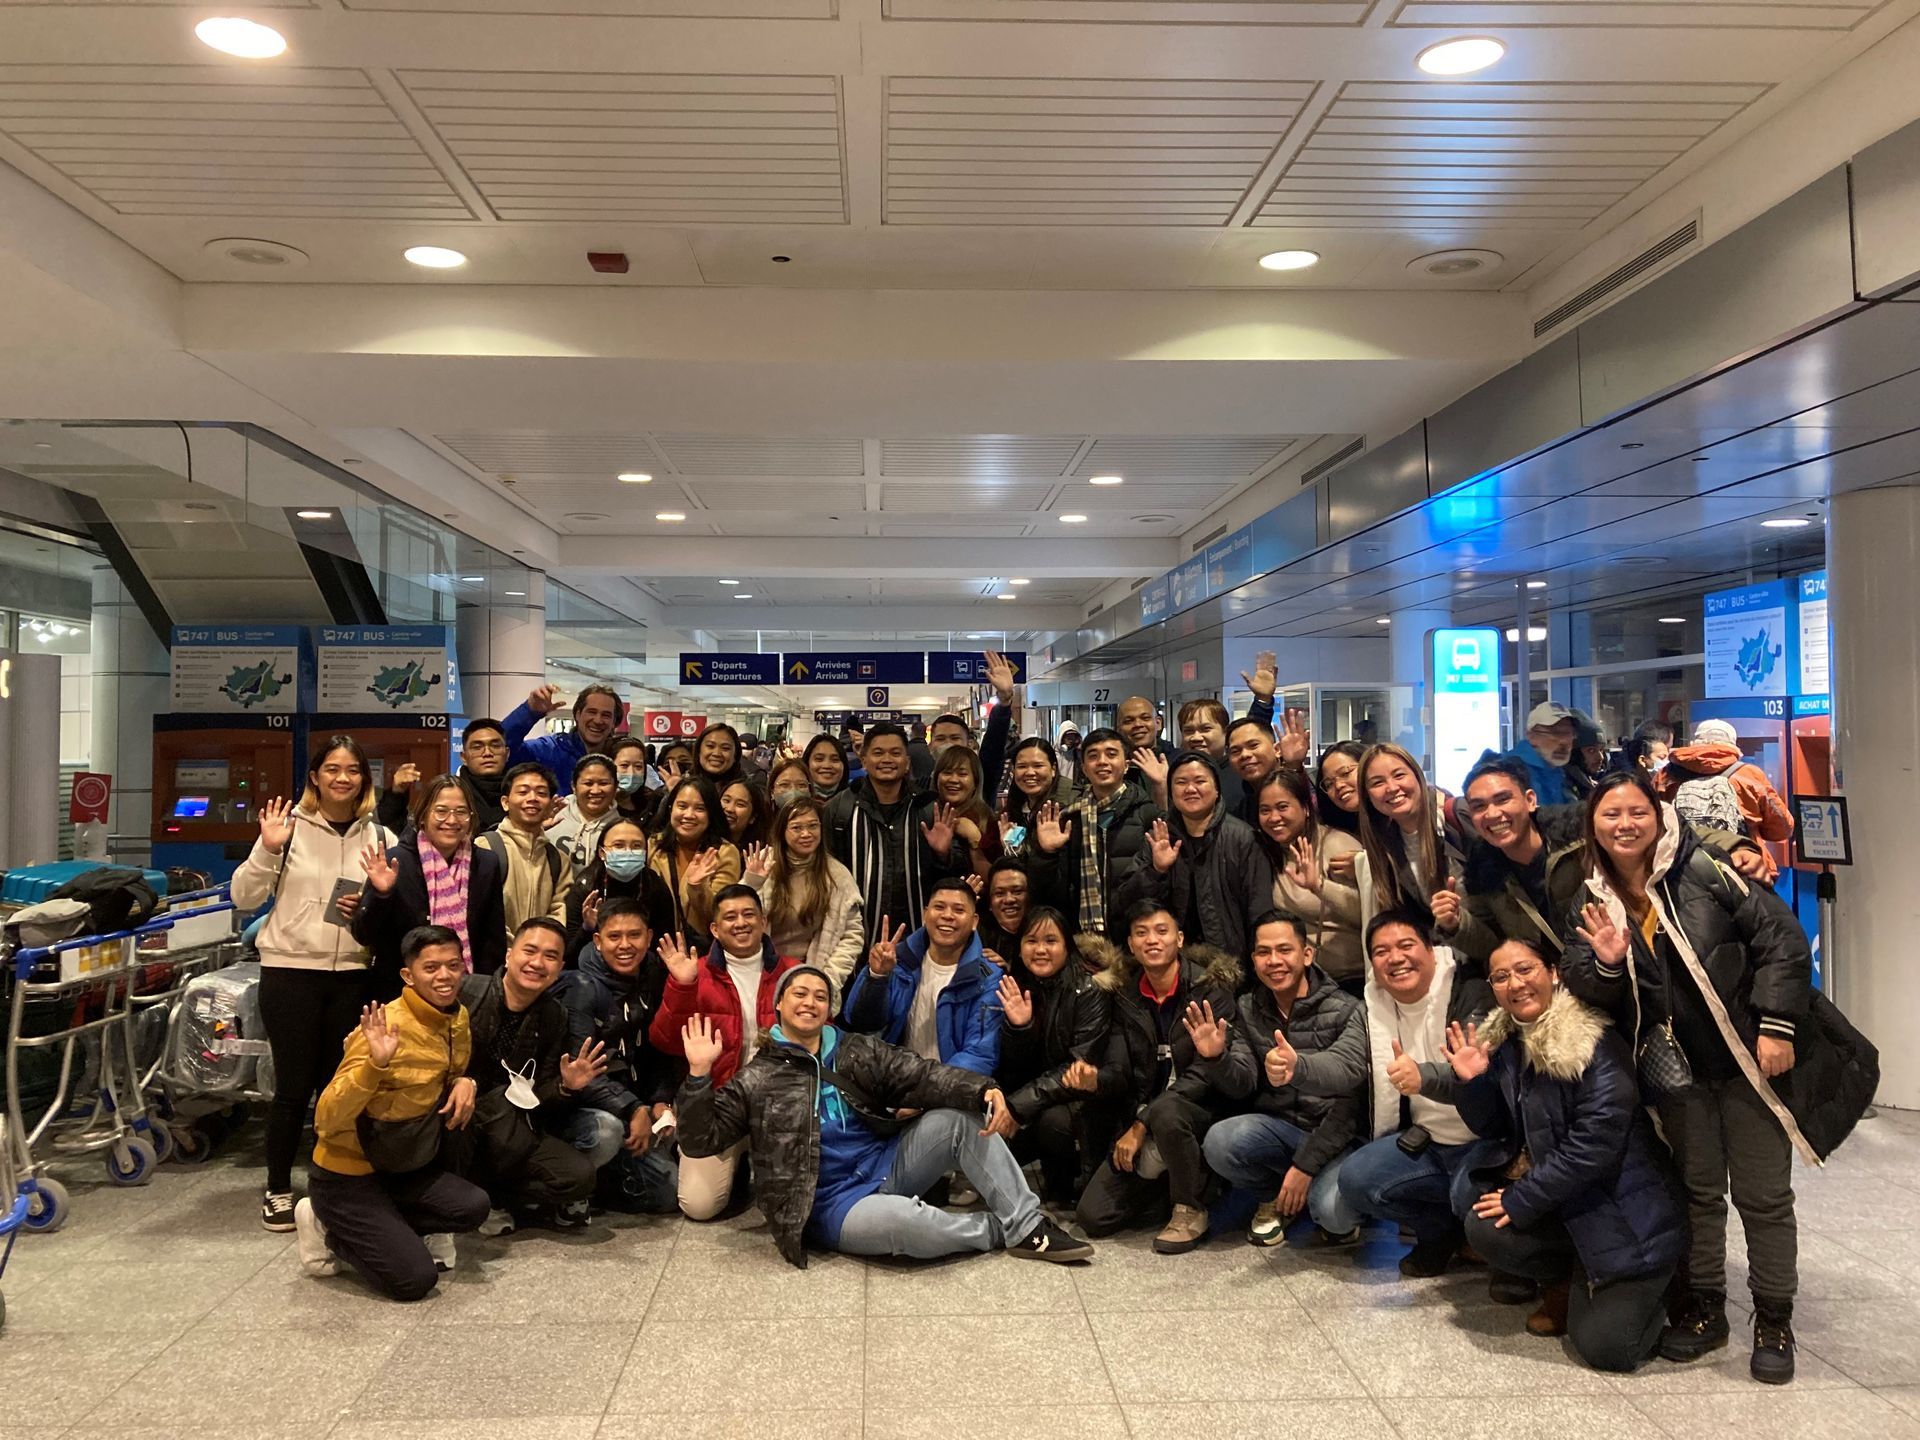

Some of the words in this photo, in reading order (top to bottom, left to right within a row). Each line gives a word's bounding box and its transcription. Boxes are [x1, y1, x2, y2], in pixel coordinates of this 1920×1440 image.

[1815, 580, 1827, 592] 74
[1715, 598, 1727, 609] 747
[1731, 595, 1745, 607] BUS
[191, 631, 209, 640] 747
[217, 631, 238, 640] BUS
[336, 631, 355, 640] 747
[363, 631, 385, 640] BUS
[711, 660, 747, 671] Départs
[815, 660, 851, 669] Arrivées
[711, 672, 762, 682] Departures
[815, 672, 849, 681] Arrivals
[1094, 688, 1110, 702] 27
[1763, 700, 1784, 715] 103
[1798, 700, 1820, 710] ACHAT
[266, 715, 290, 728] 101
[420, 715, 447, 728] 102
[1802, 821, 1823, 829] 747
[1813, 849, 1839, 857] TICKETS
